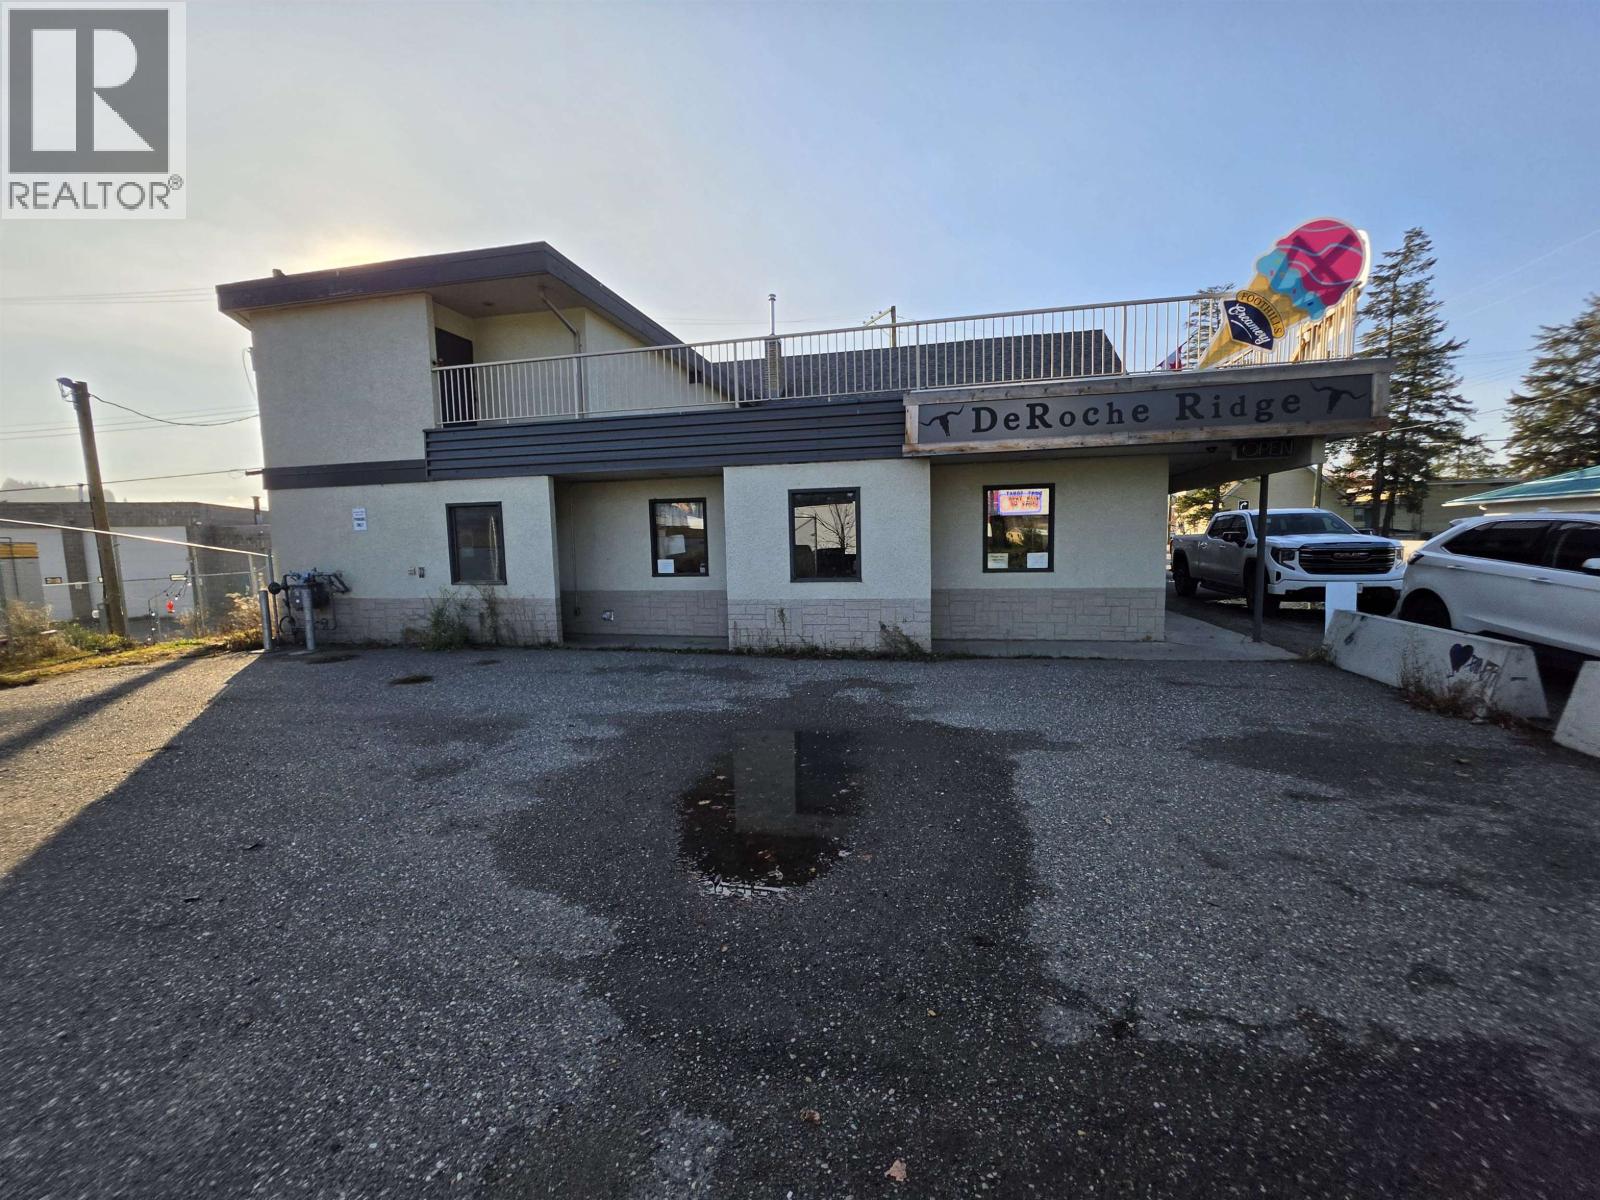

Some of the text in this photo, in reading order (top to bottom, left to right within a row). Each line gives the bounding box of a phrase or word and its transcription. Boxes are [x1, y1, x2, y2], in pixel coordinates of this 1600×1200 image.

[1228, 303, 1271, 345] Creamery
[1240, 292, 1283, 335] FOOTHILLS
[971, 392, 1300, 433] DeRoche Ridge
[1241, 439, 1296, 457] OPEN
